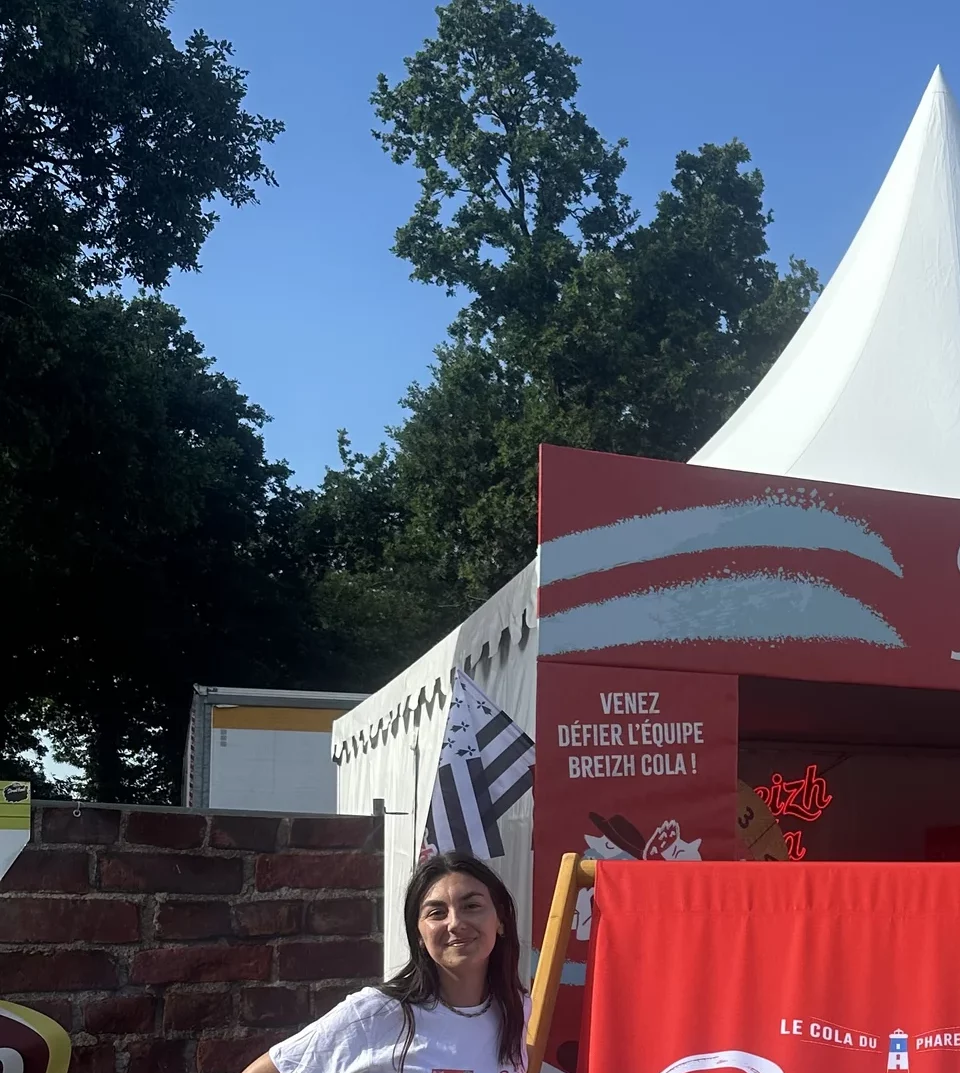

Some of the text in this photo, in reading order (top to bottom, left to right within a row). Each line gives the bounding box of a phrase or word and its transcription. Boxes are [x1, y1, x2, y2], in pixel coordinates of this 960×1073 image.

[600, 692, 660, 715] VENEZ
[558, 719, 704, 747] DÉFIER L'ÉQUIPE
[568, 754, 636, 778] BREIZH
[641, 753, 687, 776] COLA
[780, 1018, 803, 1035] LE
[810, 1022, 853, 1046] COLA
[859, 1035, 877, 1049] DU
